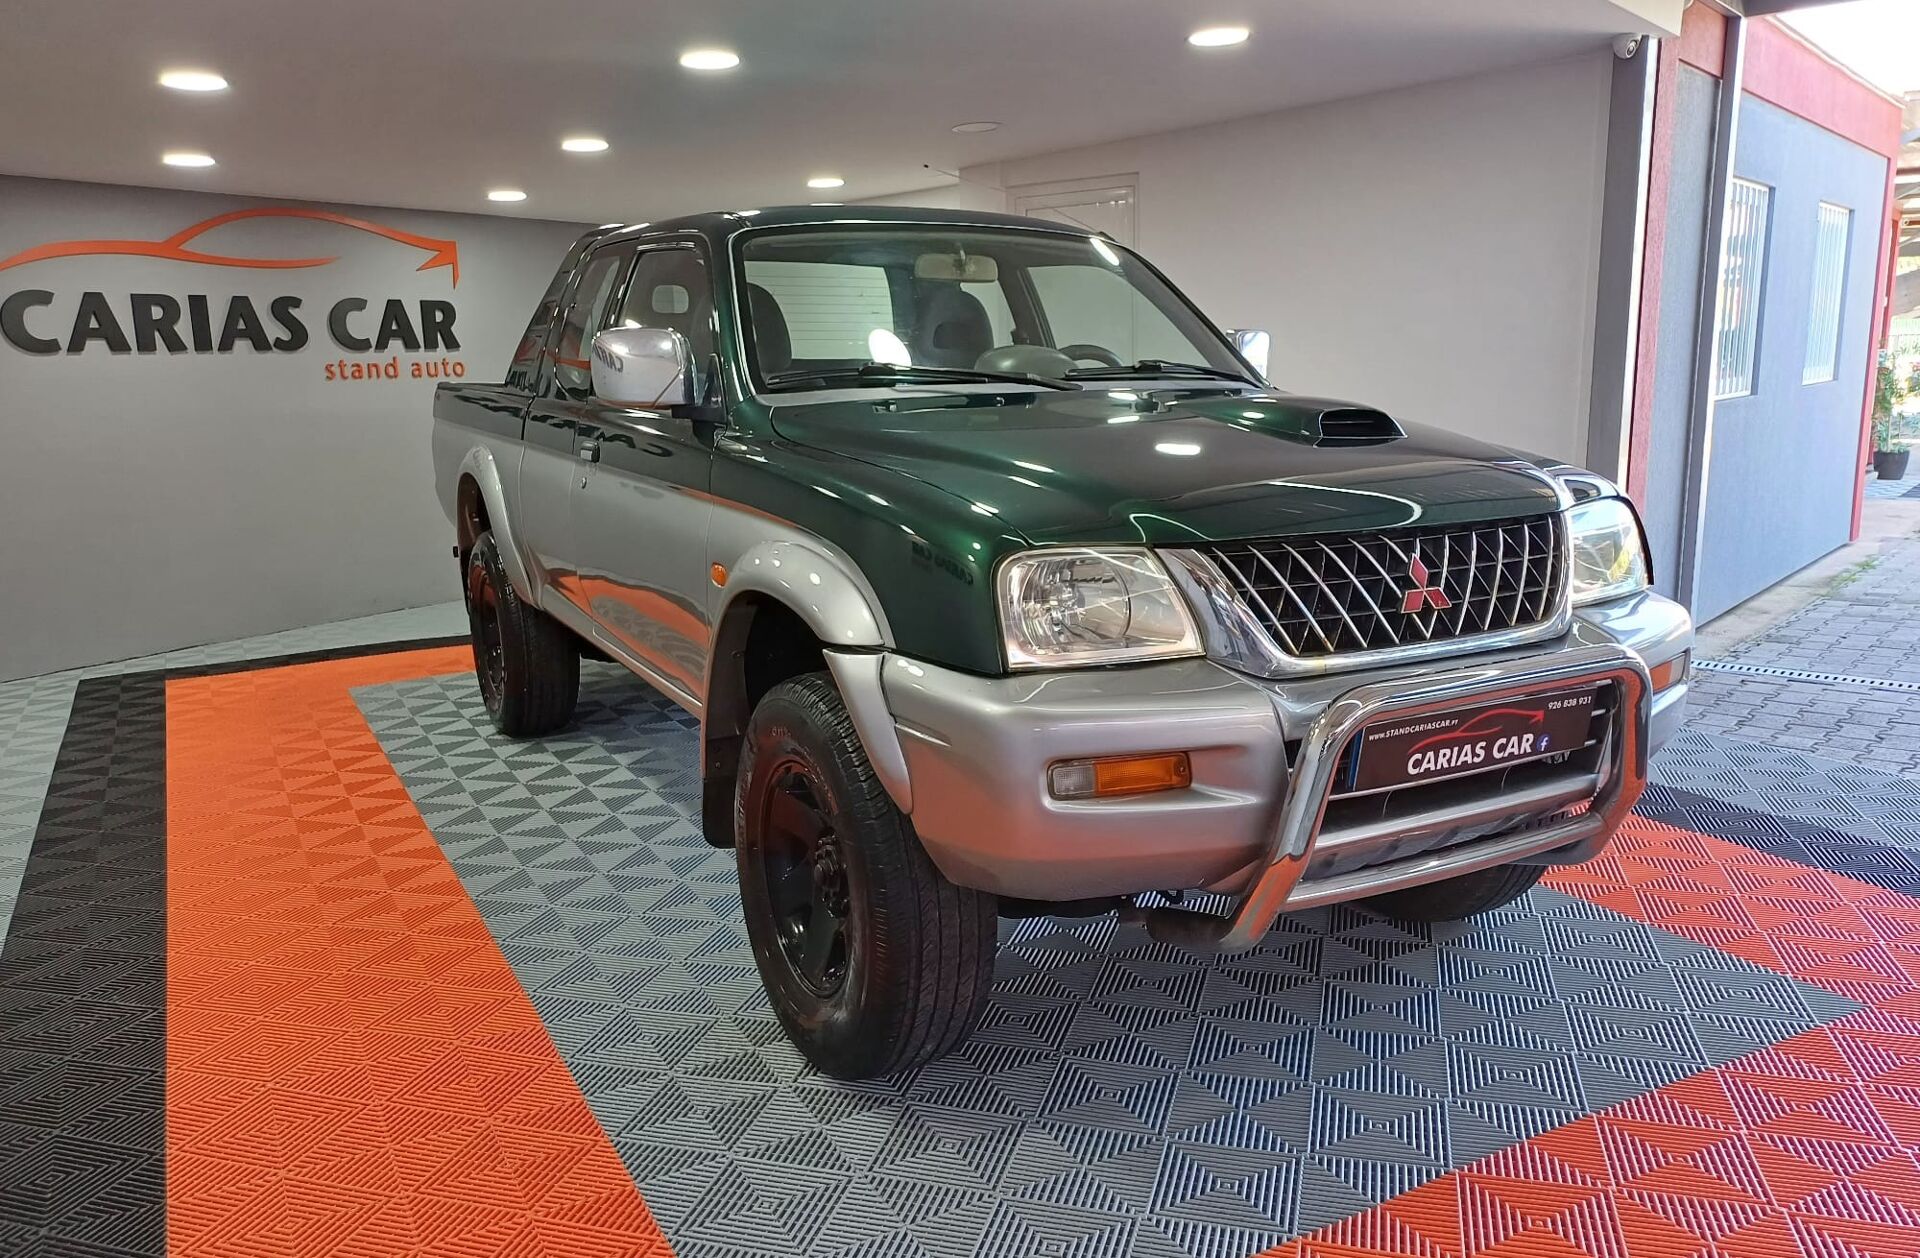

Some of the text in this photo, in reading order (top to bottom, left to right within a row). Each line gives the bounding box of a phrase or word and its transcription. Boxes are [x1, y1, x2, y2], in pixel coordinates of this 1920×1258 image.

[0, 289, 461, 354] CARIAS CAR
[324, 356, 466, 381] stand auto
[1548, 700, 1562, 710] 926
[1578, 695, 1592, 705] 931
[1407, 741, 1485, 776] CARIAS
[1492, 733, 1534, 760] CAR
